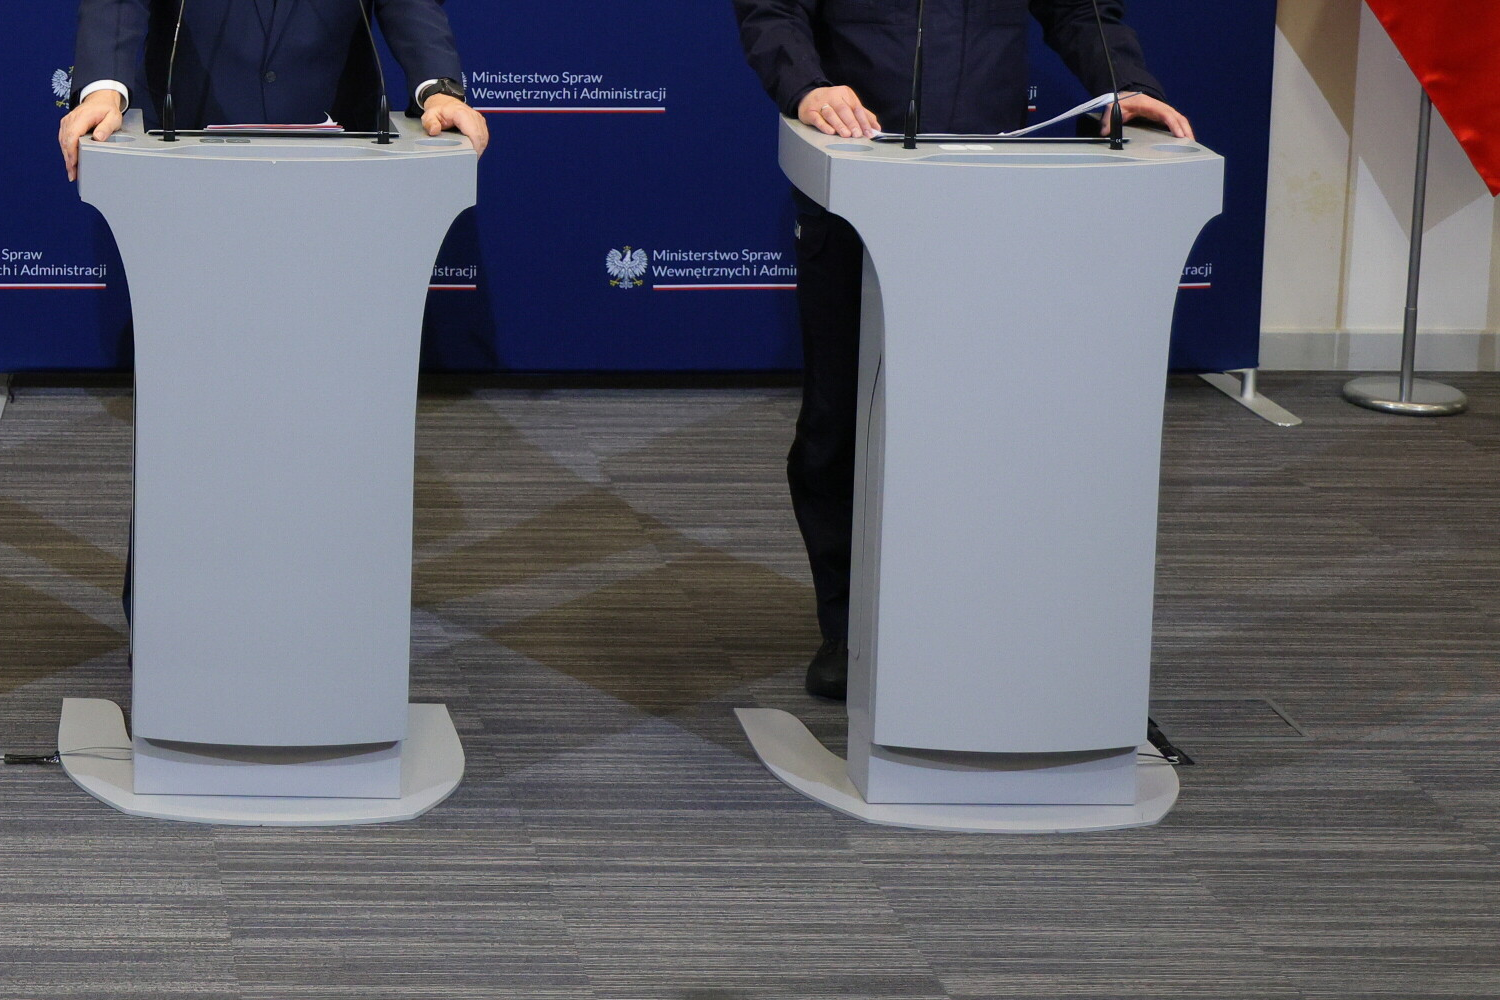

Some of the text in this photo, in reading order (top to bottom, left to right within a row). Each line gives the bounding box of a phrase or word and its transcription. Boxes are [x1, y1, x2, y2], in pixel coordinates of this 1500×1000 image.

[472, 71, 603, 86] Ministerstwo Spraw
[471, 87, 571, 102] Wewnętrznych
[579, 87, 667, 102] Administracji
[1, 248, 43, 263] Spraw
[653, 248, 782, 263] Ministerstwo Spraw
[20, 263, 107, 278] Administracji
[433, 264, 477, 280] istracji
[651, 264, 751, 279] Wewnętrznych
